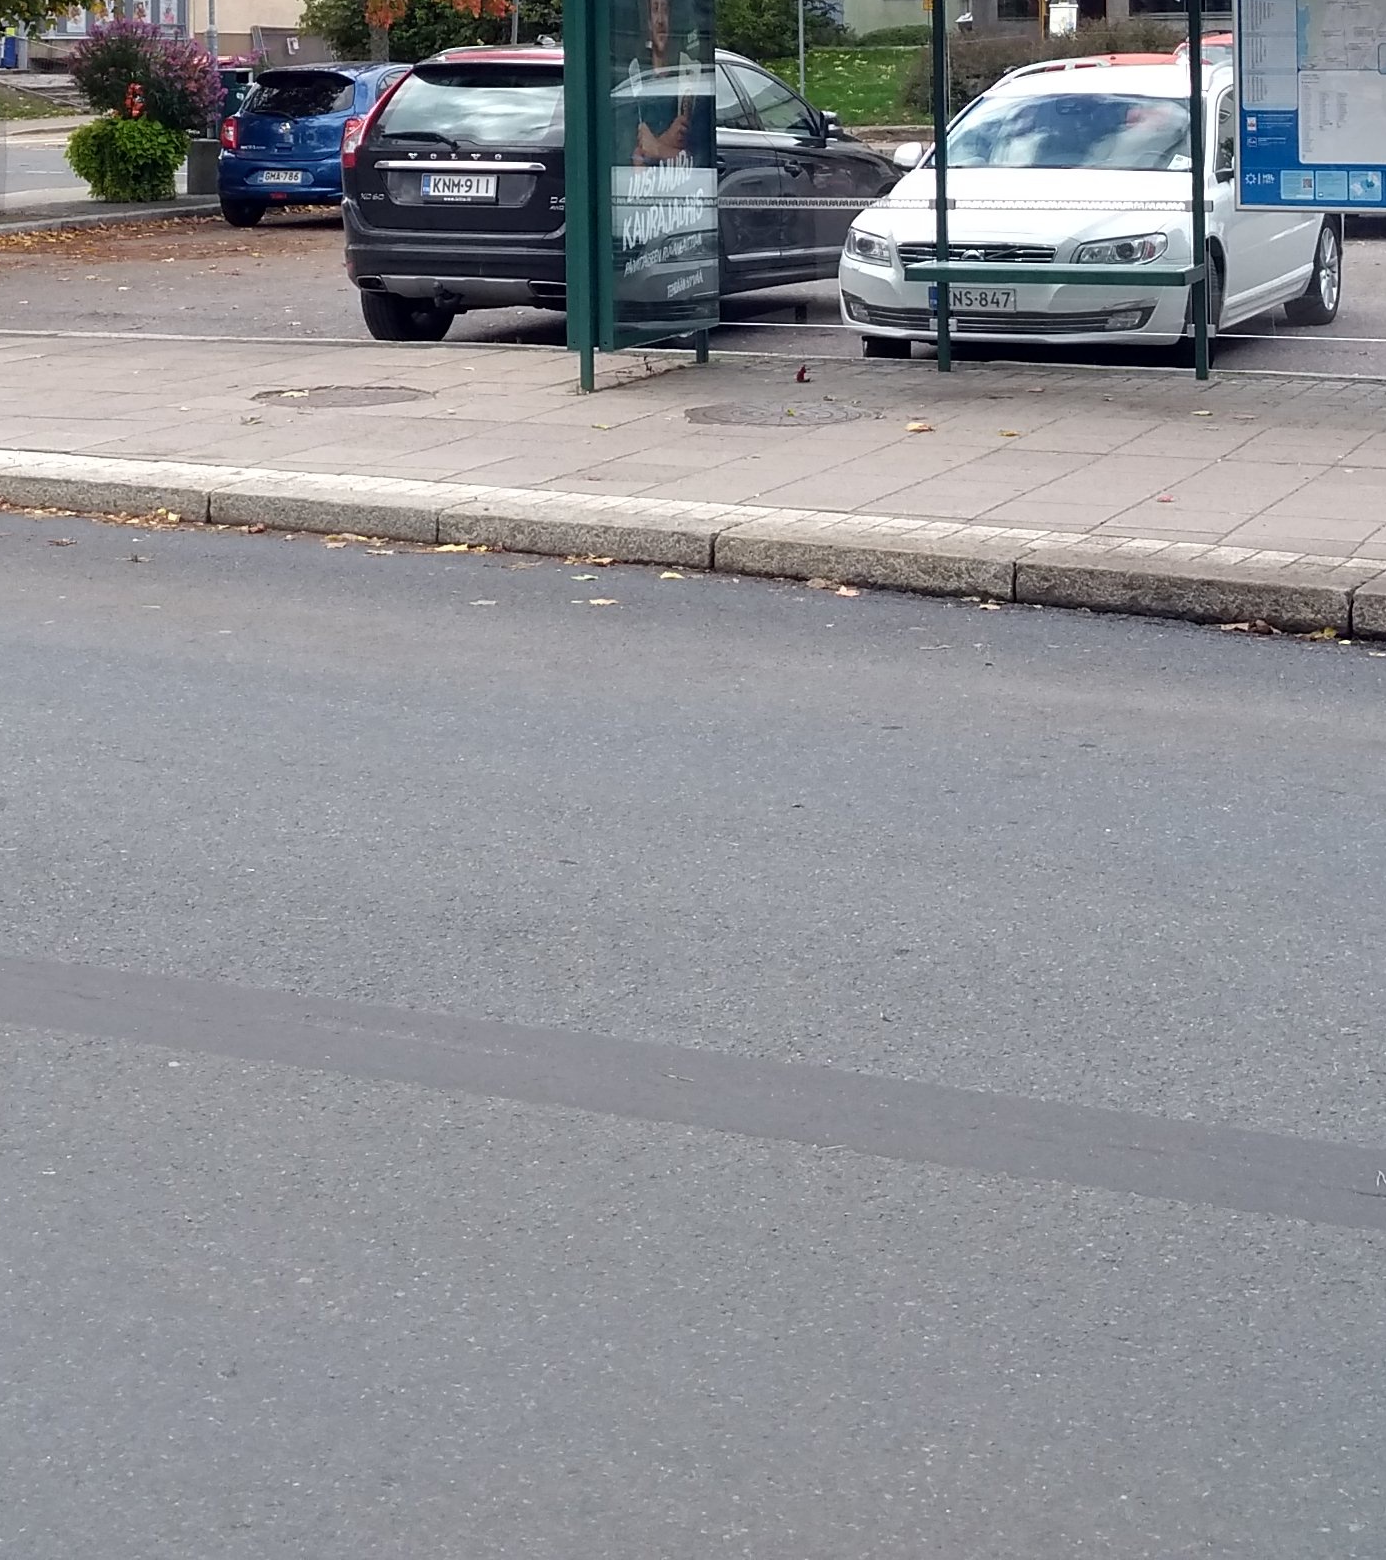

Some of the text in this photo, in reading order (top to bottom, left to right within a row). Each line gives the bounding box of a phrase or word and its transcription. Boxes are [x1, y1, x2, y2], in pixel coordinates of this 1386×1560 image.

[407, 152, 503, 161] VOLVO
[264, 171, 300, 181] GMA-786
[627, 150, 693, 202] UUSI MURU
[432, 177, 491, 194] KNM-911
[949, 290, 1011, 308] NS-847
